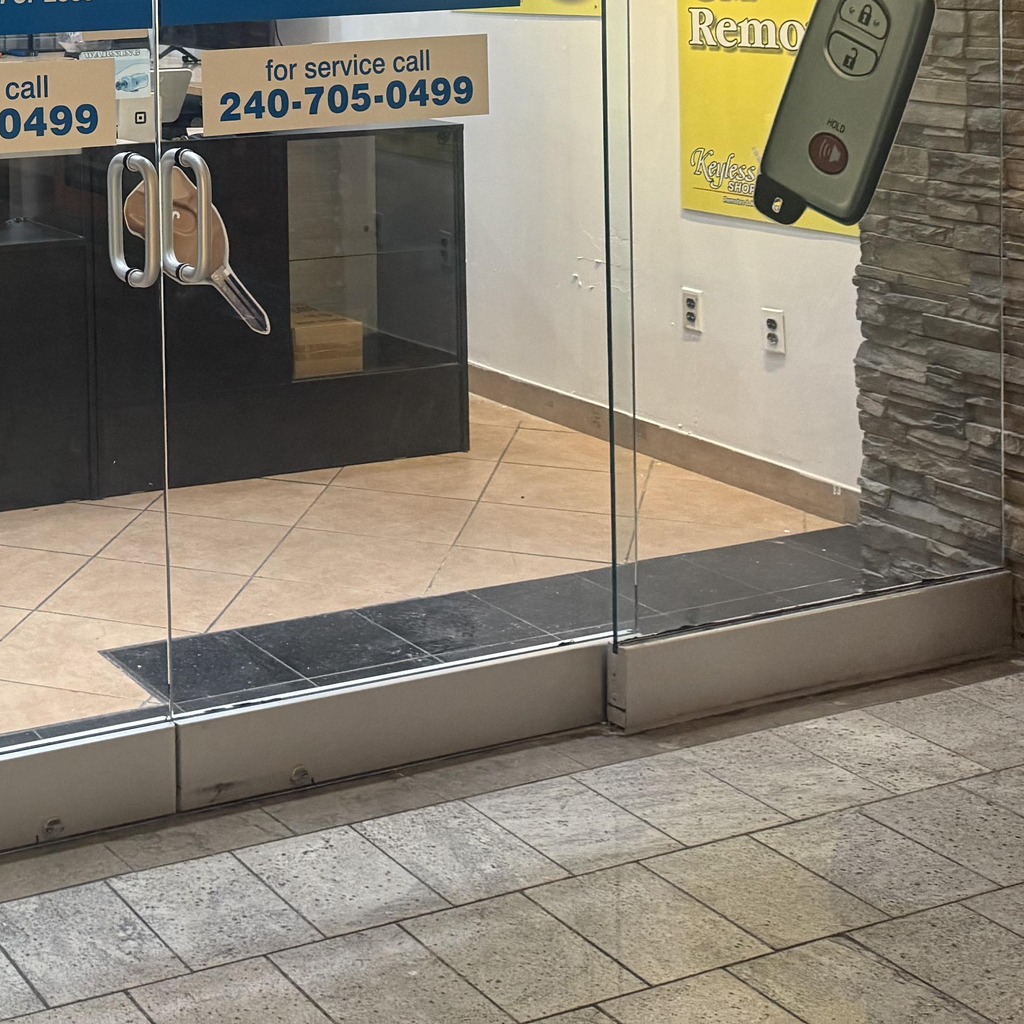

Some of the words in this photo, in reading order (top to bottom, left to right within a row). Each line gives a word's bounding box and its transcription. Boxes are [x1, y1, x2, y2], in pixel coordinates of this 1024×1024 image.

[689, 7, 806, 51] Remo
[265, 59, 297, 81] for
[304, 55, 385, 79] service
[393, 49, 430, 73] call
[5, 75, 49, 100] call
[219, 75, 474, 122] 240-705-0499
[827, 117, 845, 133] HOLD
[690, 148, 756, 189] Keyless
